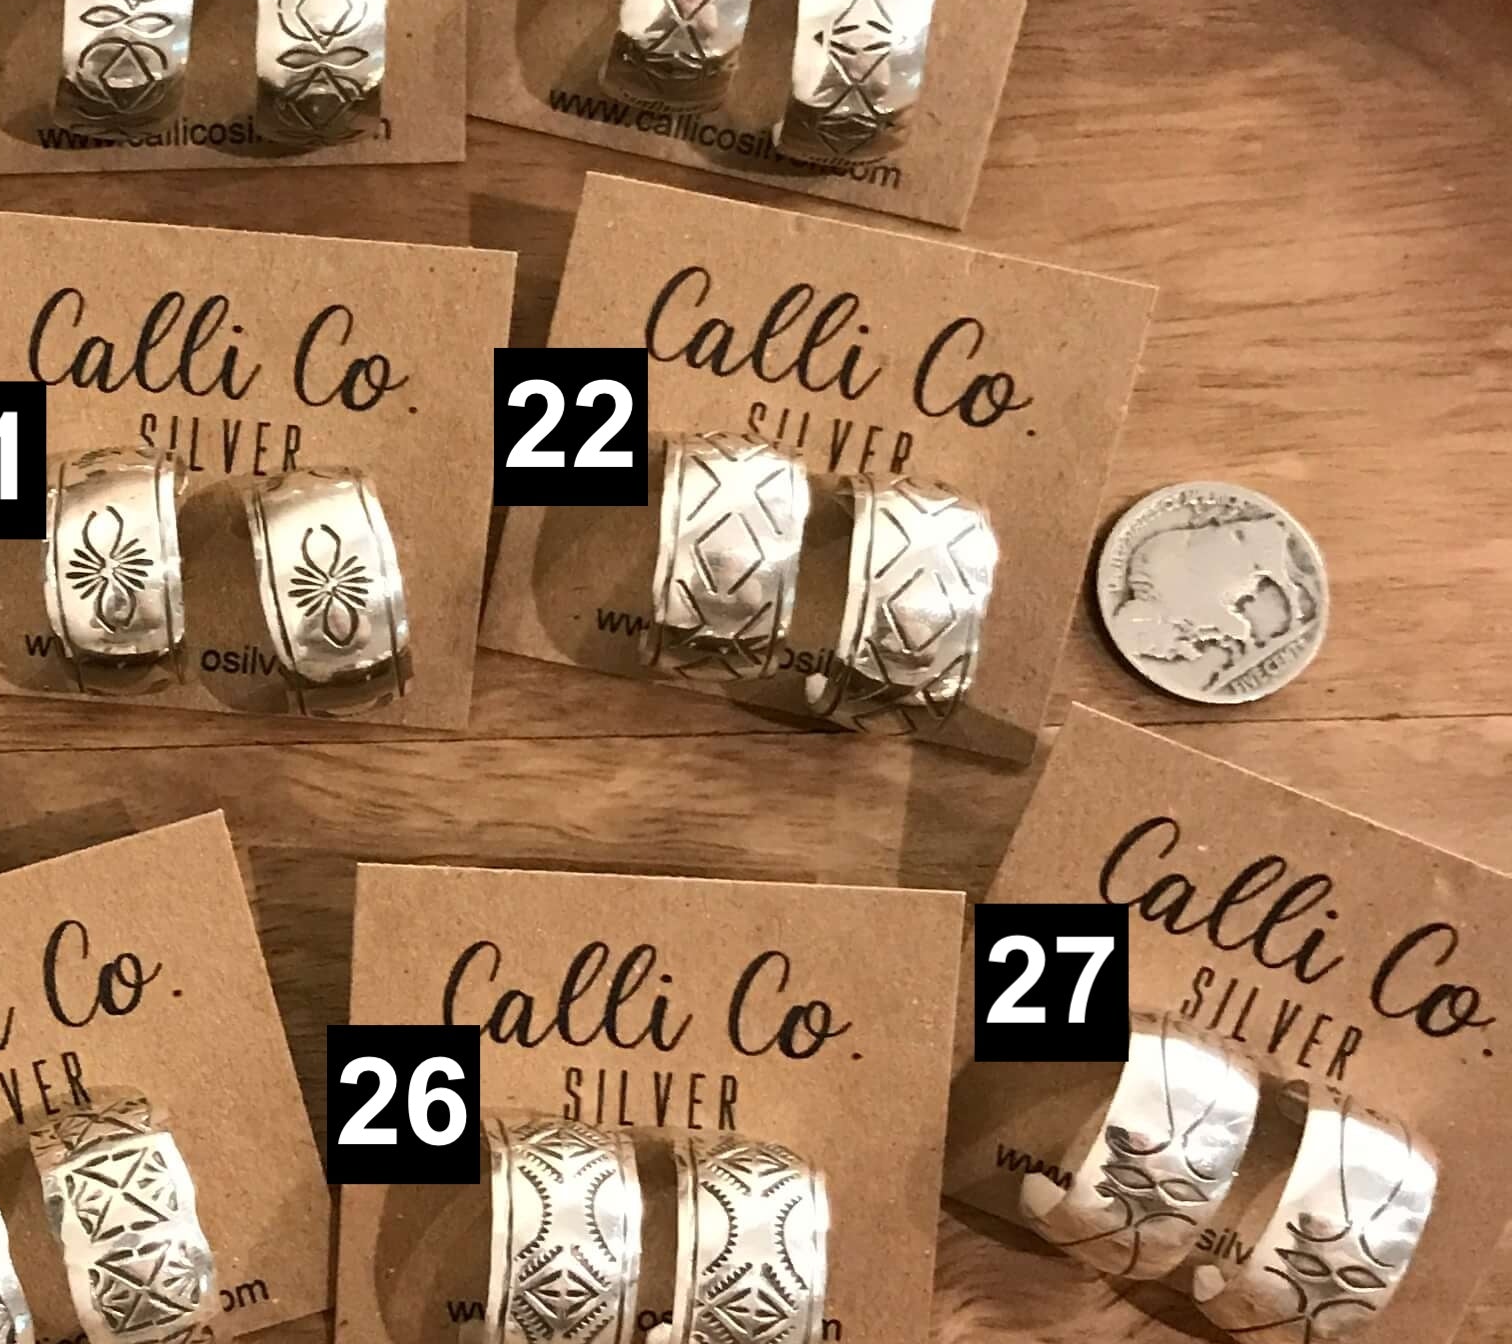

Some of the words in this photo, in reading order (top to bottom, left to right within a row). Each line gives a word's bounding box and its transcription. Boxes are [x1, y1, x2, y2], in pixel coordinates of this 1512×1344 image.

[28, 287, 261, 401] Calli
[294, 304, 418, 415] Co.
[644, 266, 881, 400] Calli
[913, 317, 1038, 437] Co.
[140, 413, 301, 476] SILVER
[748, 401, 912, 474] SILVER
[43, 919, 183, 1028] Co.
[1098, 816, 1344, 985] Calli
[1369, 922, 1497, 1059] Co.
[442, 940, 693, 1052] Calli
[728, 950, 864, 1061] Co.
[1179, 966, 1364, 1081] SILVER
[563, 1067, 737, 1131] SILVER
